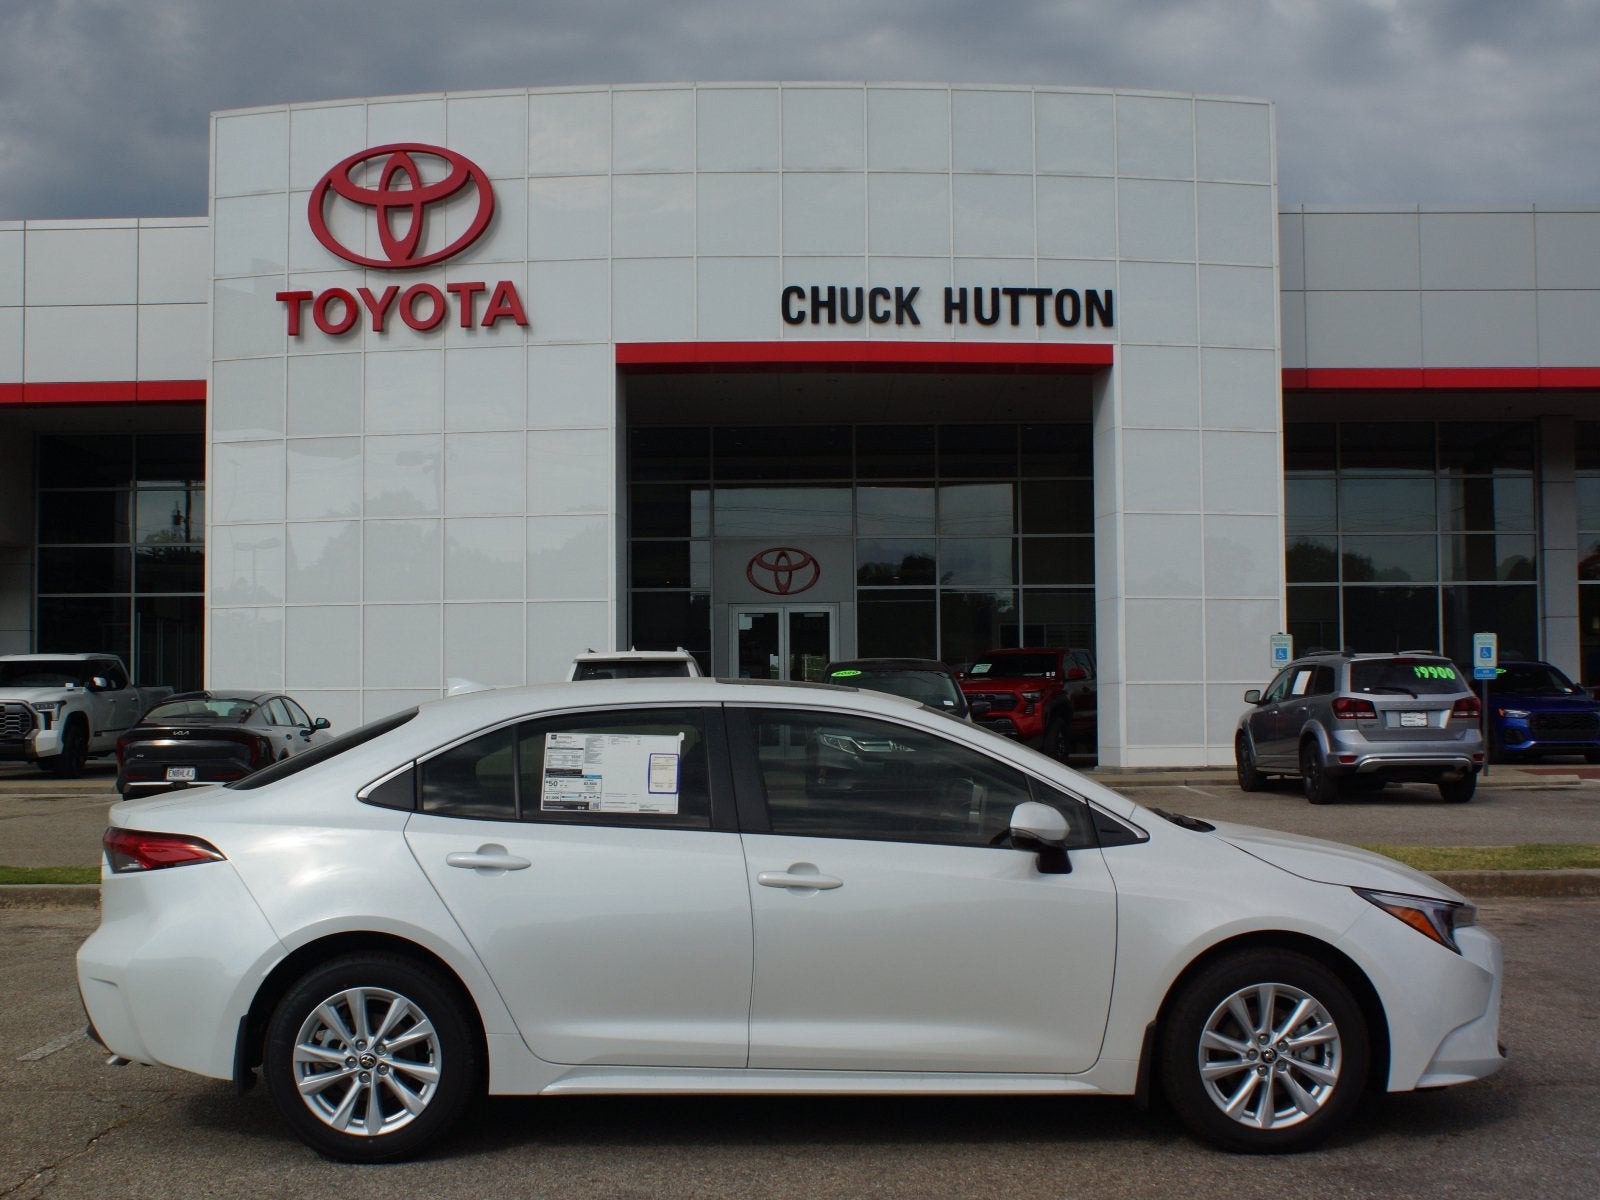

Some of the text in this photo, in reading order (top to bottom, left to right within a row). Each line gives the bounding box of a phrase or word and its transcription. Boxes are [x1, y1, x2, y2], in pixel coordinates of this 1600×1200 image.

[276, 280, 529, 336] TOYOTA
[781, 285, 1114, 327] CHUCK HUTTON
